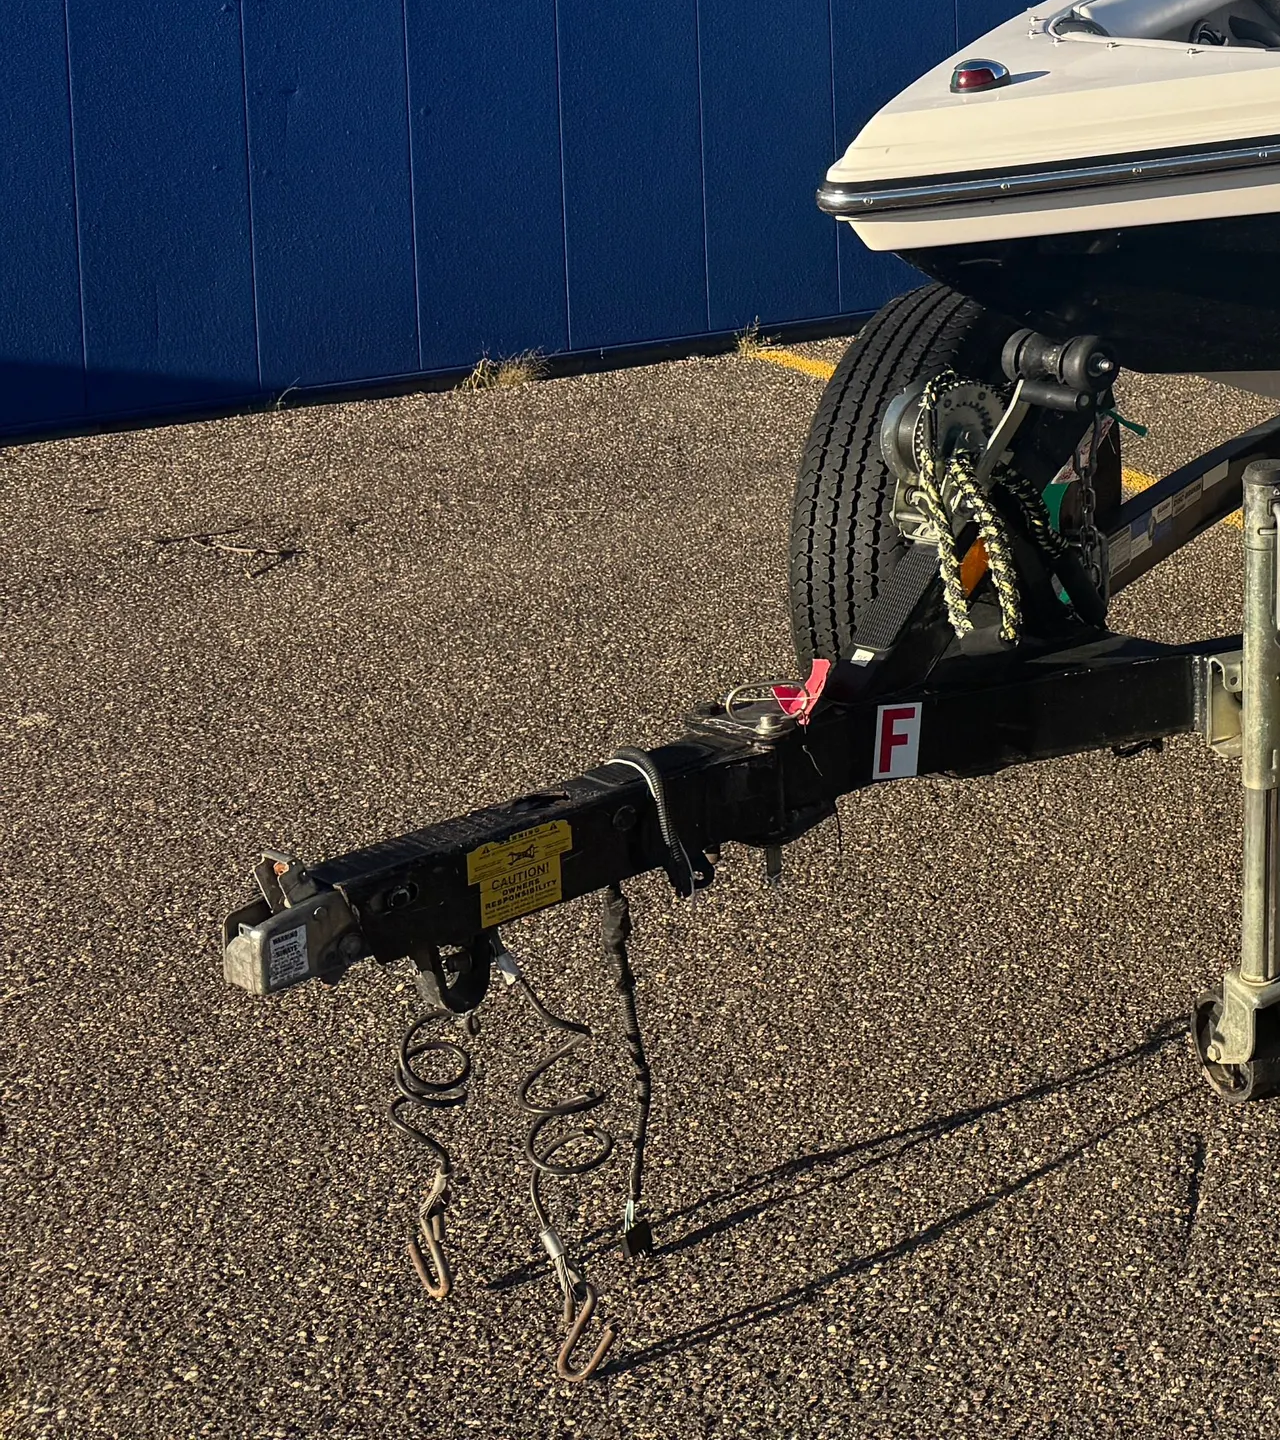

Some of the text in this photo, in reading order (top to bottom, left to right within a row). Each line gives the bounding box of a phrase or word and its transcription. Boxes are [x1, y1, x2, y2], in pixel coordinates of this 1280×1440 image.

[879, 707, 916, 773] F
[492, 862, 549, 890] CAUTION!
[502, 878, 540, 896] OWNERS
[485, 880, 557, 910] RESPONSIBILITY
